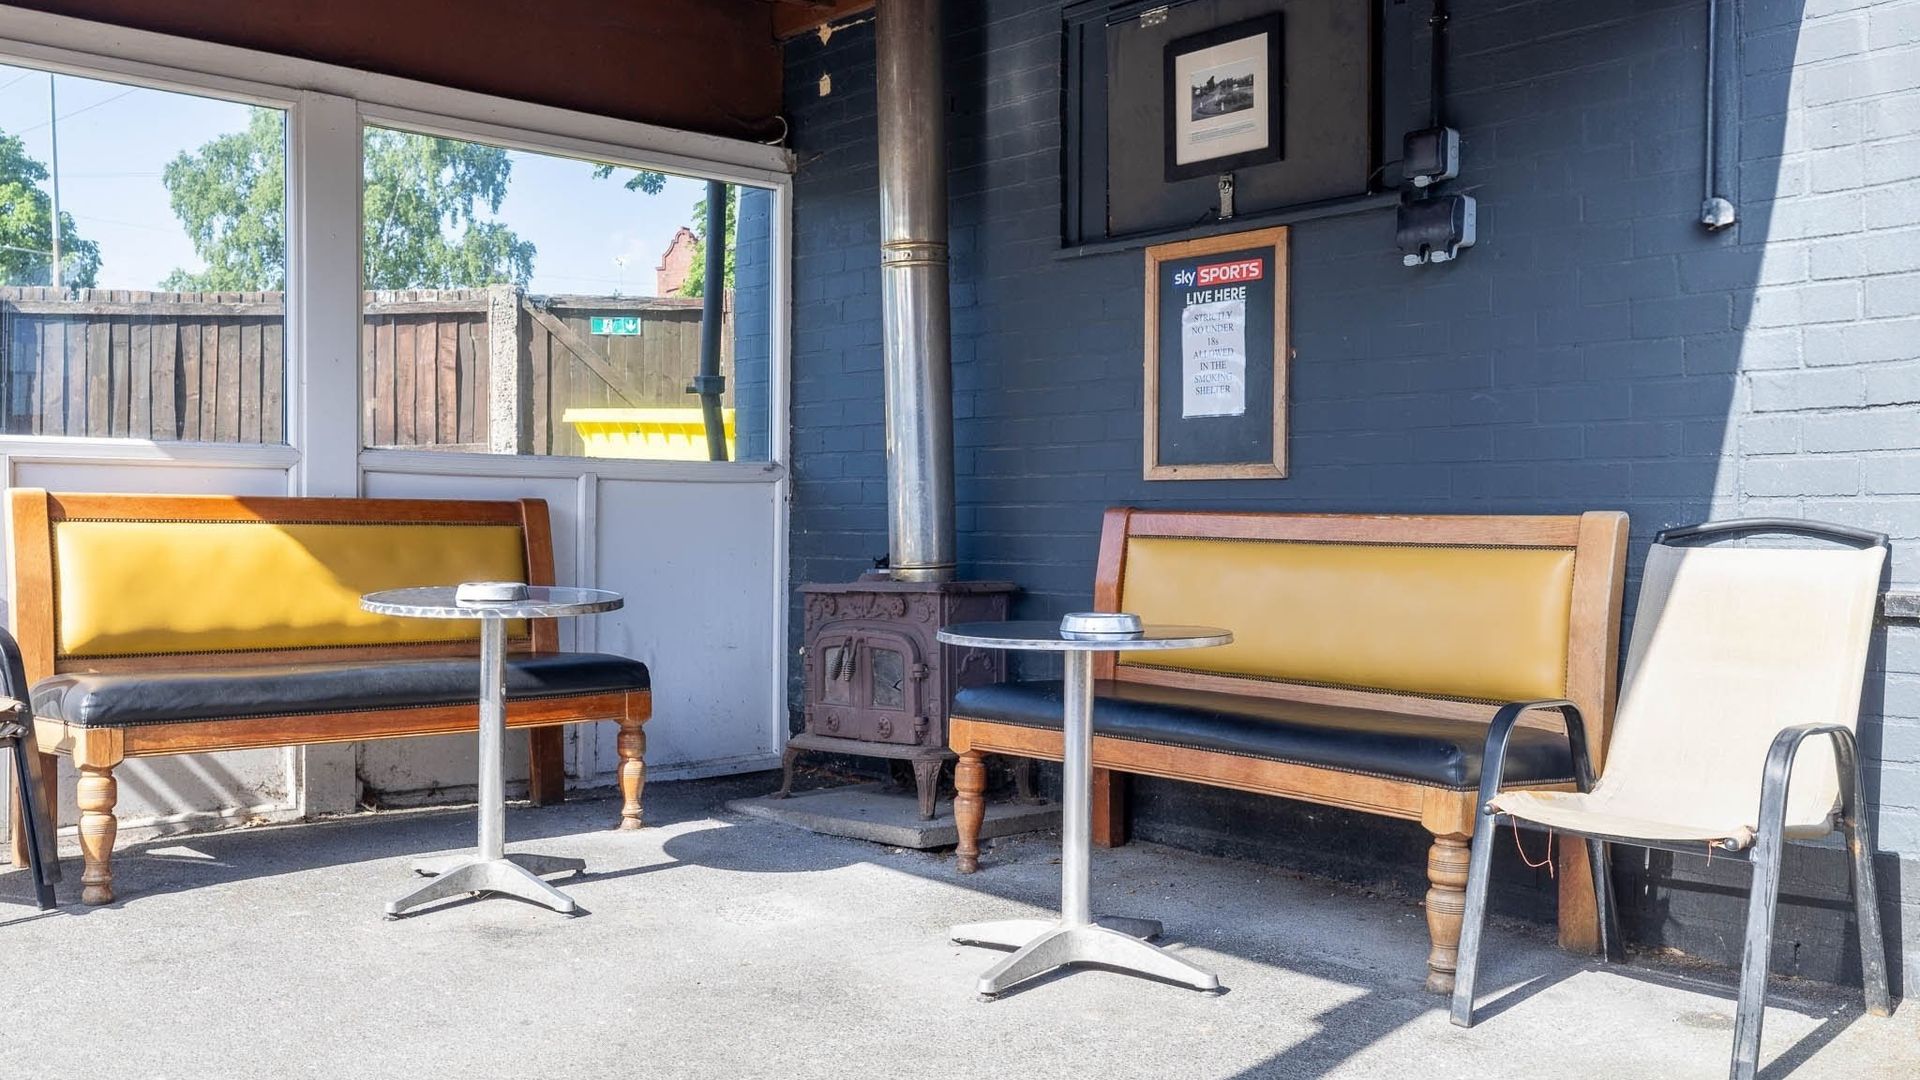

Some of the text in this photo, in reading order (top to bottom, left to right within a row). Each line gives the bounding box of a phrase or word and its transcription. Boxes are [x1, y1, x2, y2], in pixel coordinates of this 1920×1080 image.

[1174, 262, 1260, 287] sky SPORTS
[1186, 286, 1246, 305] LIVE HERE
[1194, 311, 1233, 322] STRICTLY
[1192, 323, 1234, 335] NO UNDER
[1207, 337, 1219, 346] 18s
[1193, 347, 1234, 360] ALLOWED
[1200, 360, 1227, 371] IN THE
[1194, 372, 1233, 384] SMOKING
[1195, 385, 1231, 396] SHELTER
